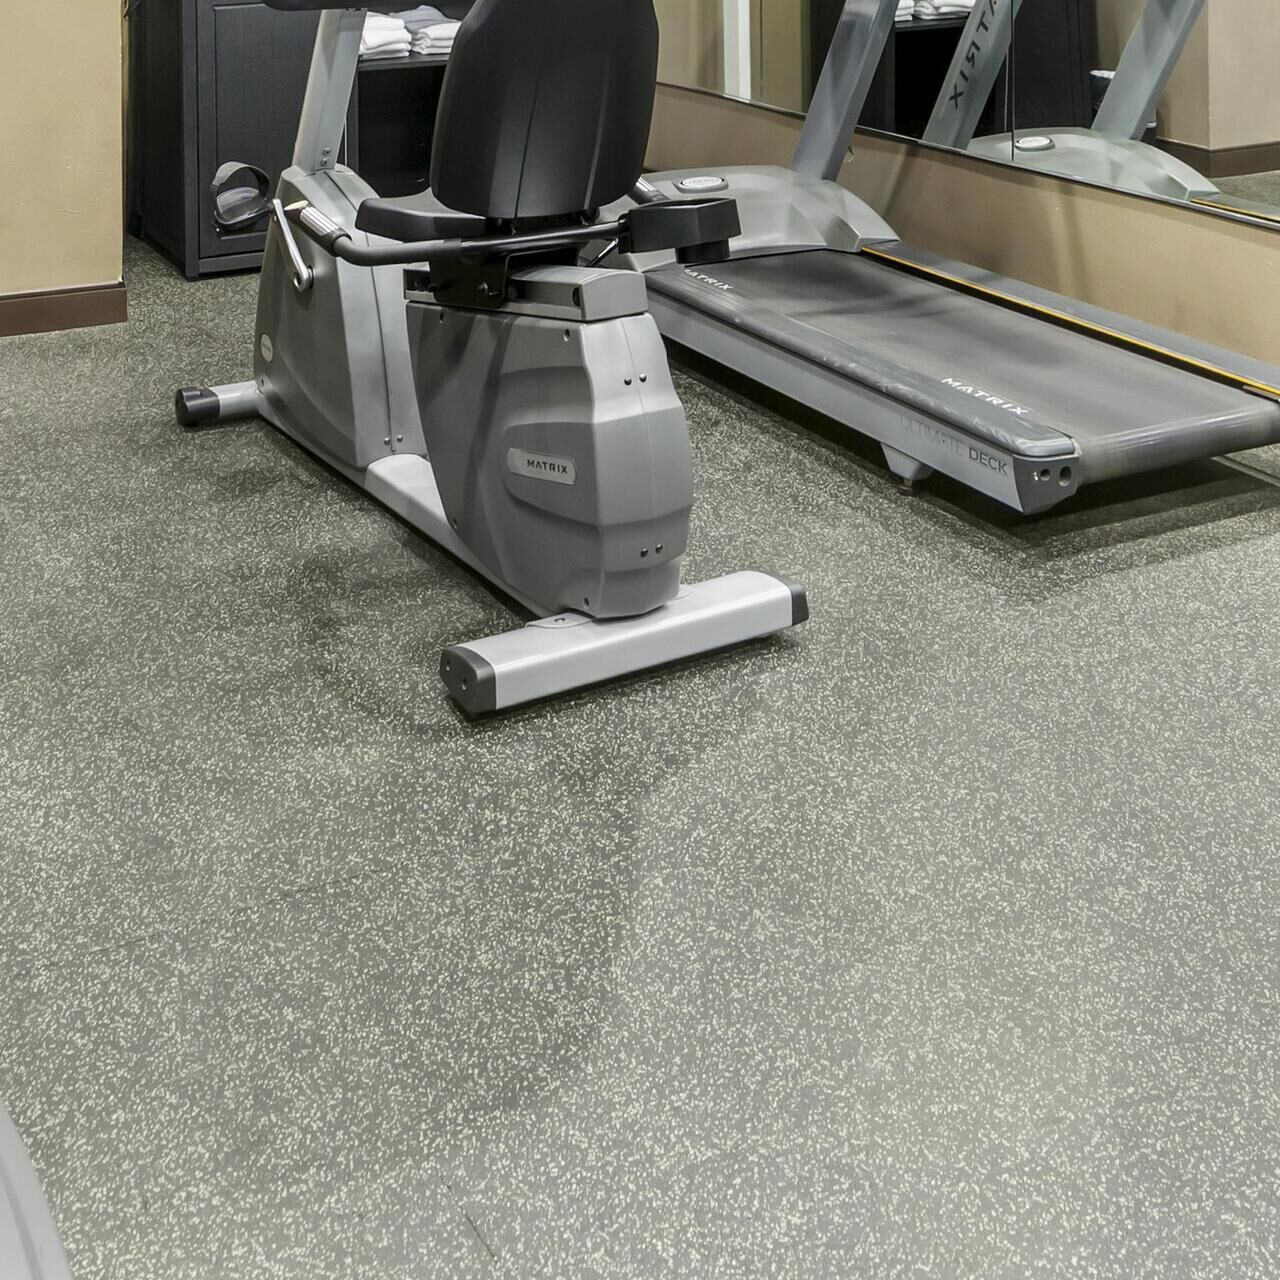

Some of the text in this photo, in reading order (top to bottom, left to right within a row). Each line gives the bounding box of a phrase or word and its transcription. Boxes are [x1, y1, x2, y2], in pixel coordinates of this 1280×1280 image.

[941, 377, 1029, 416] MATRIX
[899, 414, 1009, 477] ULTIMATE DECK
[527, 458, 568, 474] MATRIX
